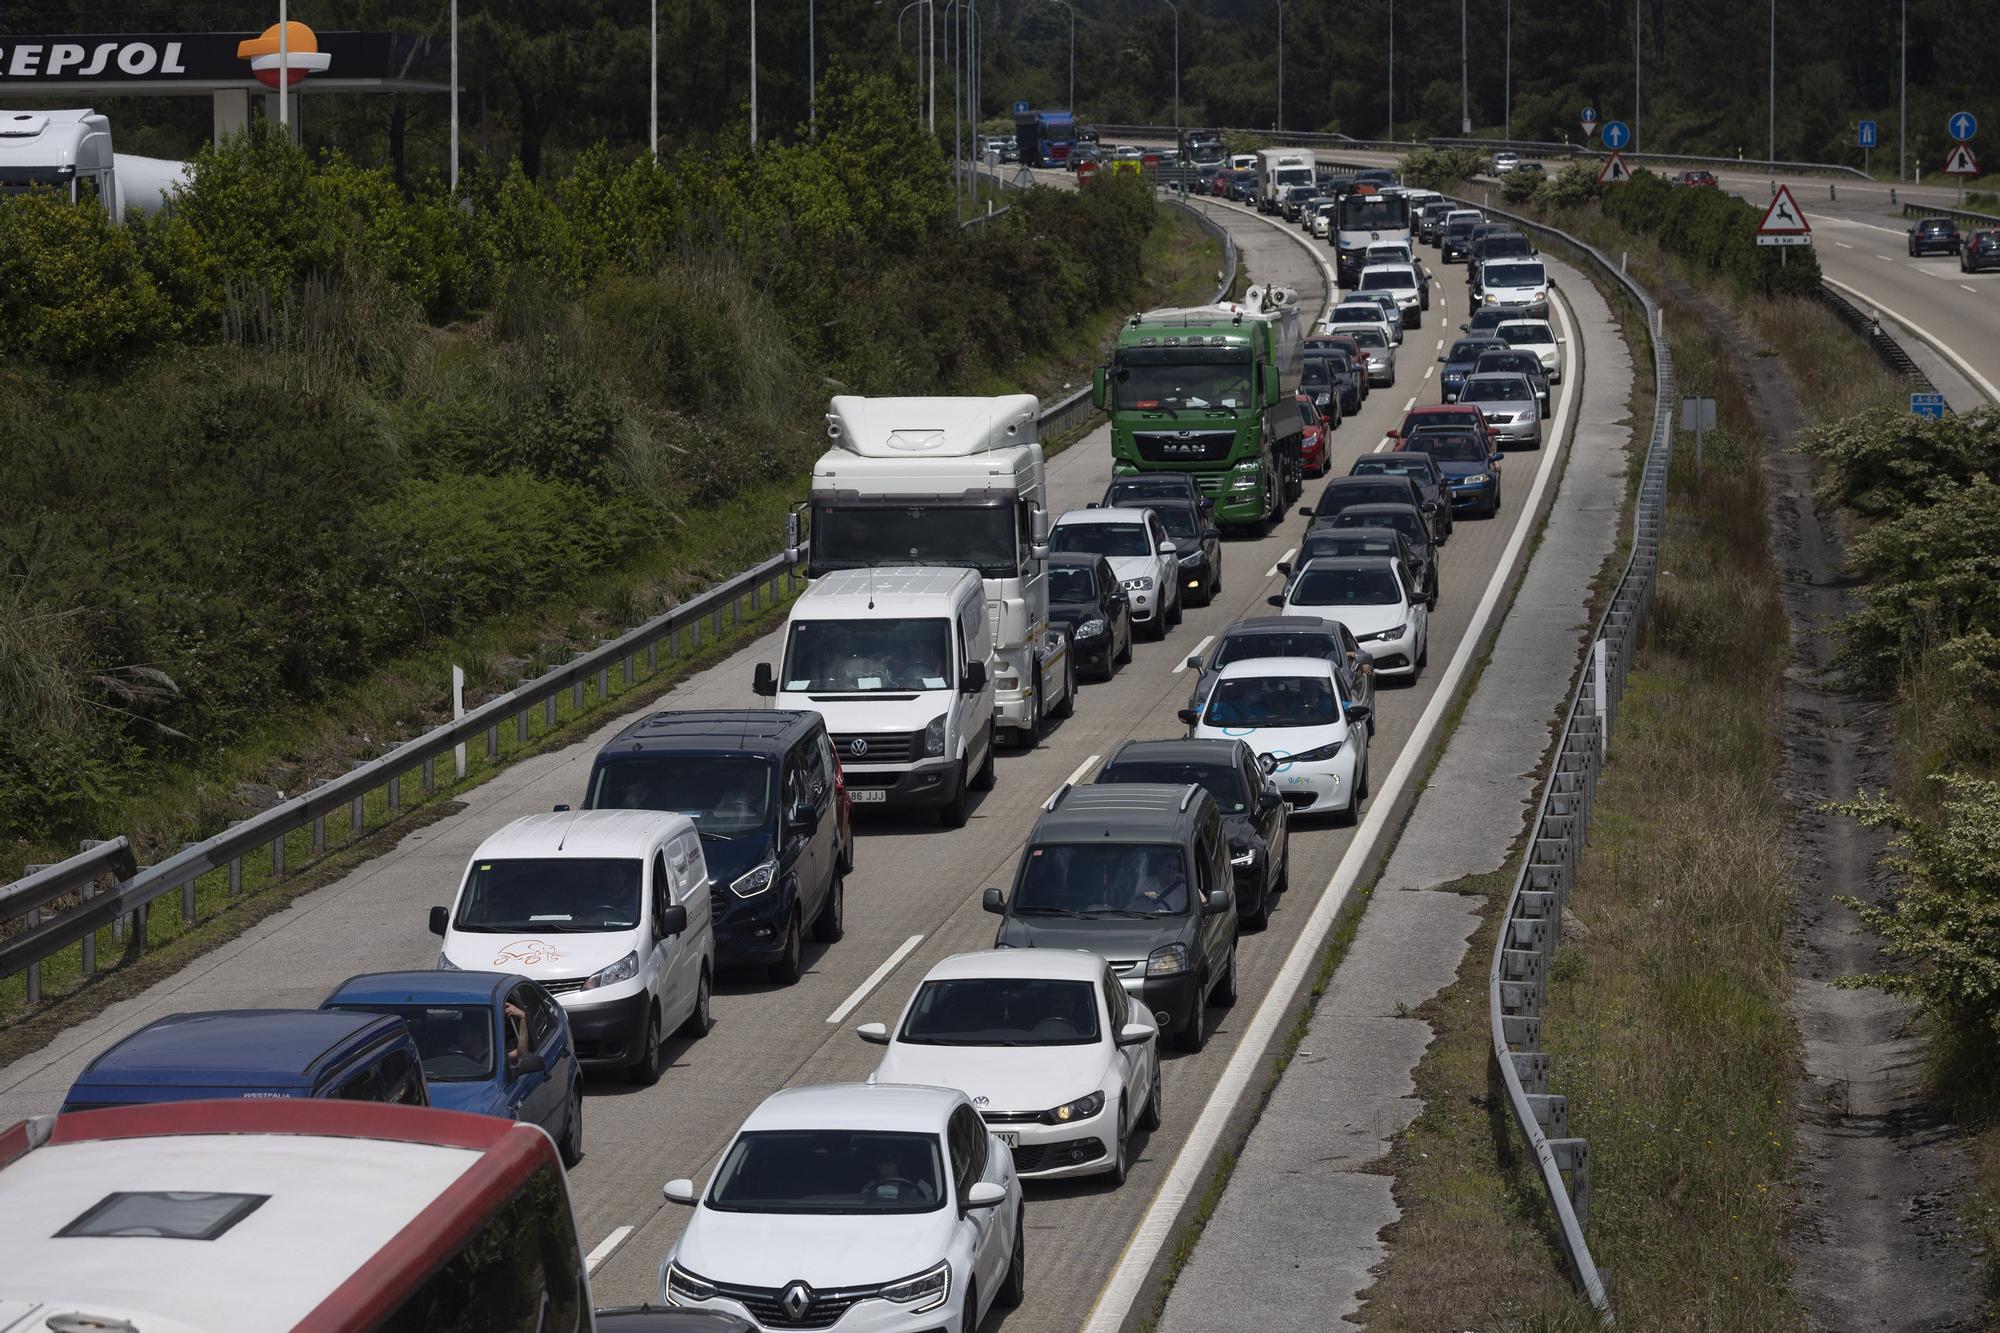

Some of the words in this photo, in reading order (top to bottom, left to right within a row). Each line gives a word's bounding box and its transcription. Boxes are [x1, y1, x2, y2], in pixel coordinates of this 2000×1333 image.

[0, 42, 186, 76] EPSOL
[1163, 444, 1206, 454] MAN
[865, 791, 884, 801] JJJ
